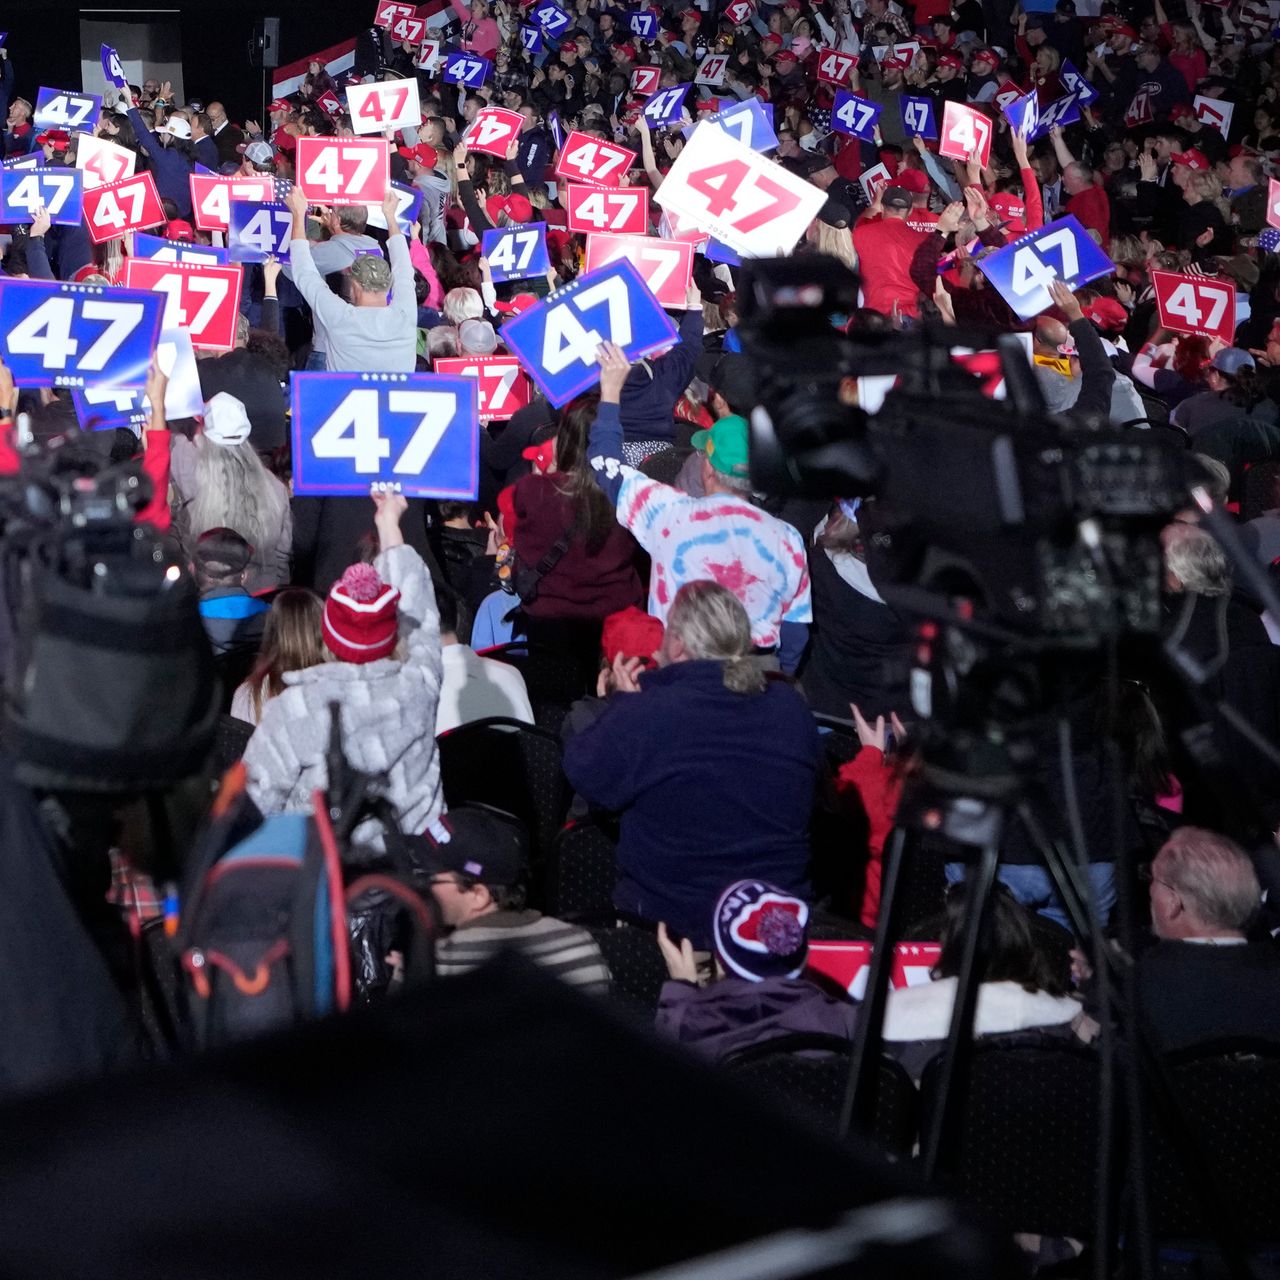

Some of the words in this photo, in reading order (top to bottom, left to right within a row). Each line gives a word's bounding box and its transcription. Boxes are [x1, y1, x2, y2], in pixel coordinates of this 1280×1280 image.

[538, 7, 567, 29] 47
[631, 16, 652, 34] 47
[449, 60, 482, 81] 47
[822, 55, 852, 80] 47
[40, 97, 94, 123] 47
[359, 88, 408, 122] 47
[837, 100, 874, 132] 47
[905, 102, 928, 131] 47
[949, 116, 990, 152] 47
[305, 147, 378, 194] 47
[567, 143, 626, 179] 47
[8, 174, 75, 215] 47
[94, 182, 146, 228] 47
[575, 193, 638, 227] 47
[686, 159, 802, 233] 47
[708, 224, 729, 239] 2024
[488, 230, 539, 271] 47
[1011, 228, 1078, 297] 47
[1166, 283, 1228, 329] 47
[7, 297, 144, 370] 47
[542, 275, 632, 374] 47
[55, 376, 84, 386] 2024
[312, 390, 456, 474] 47
